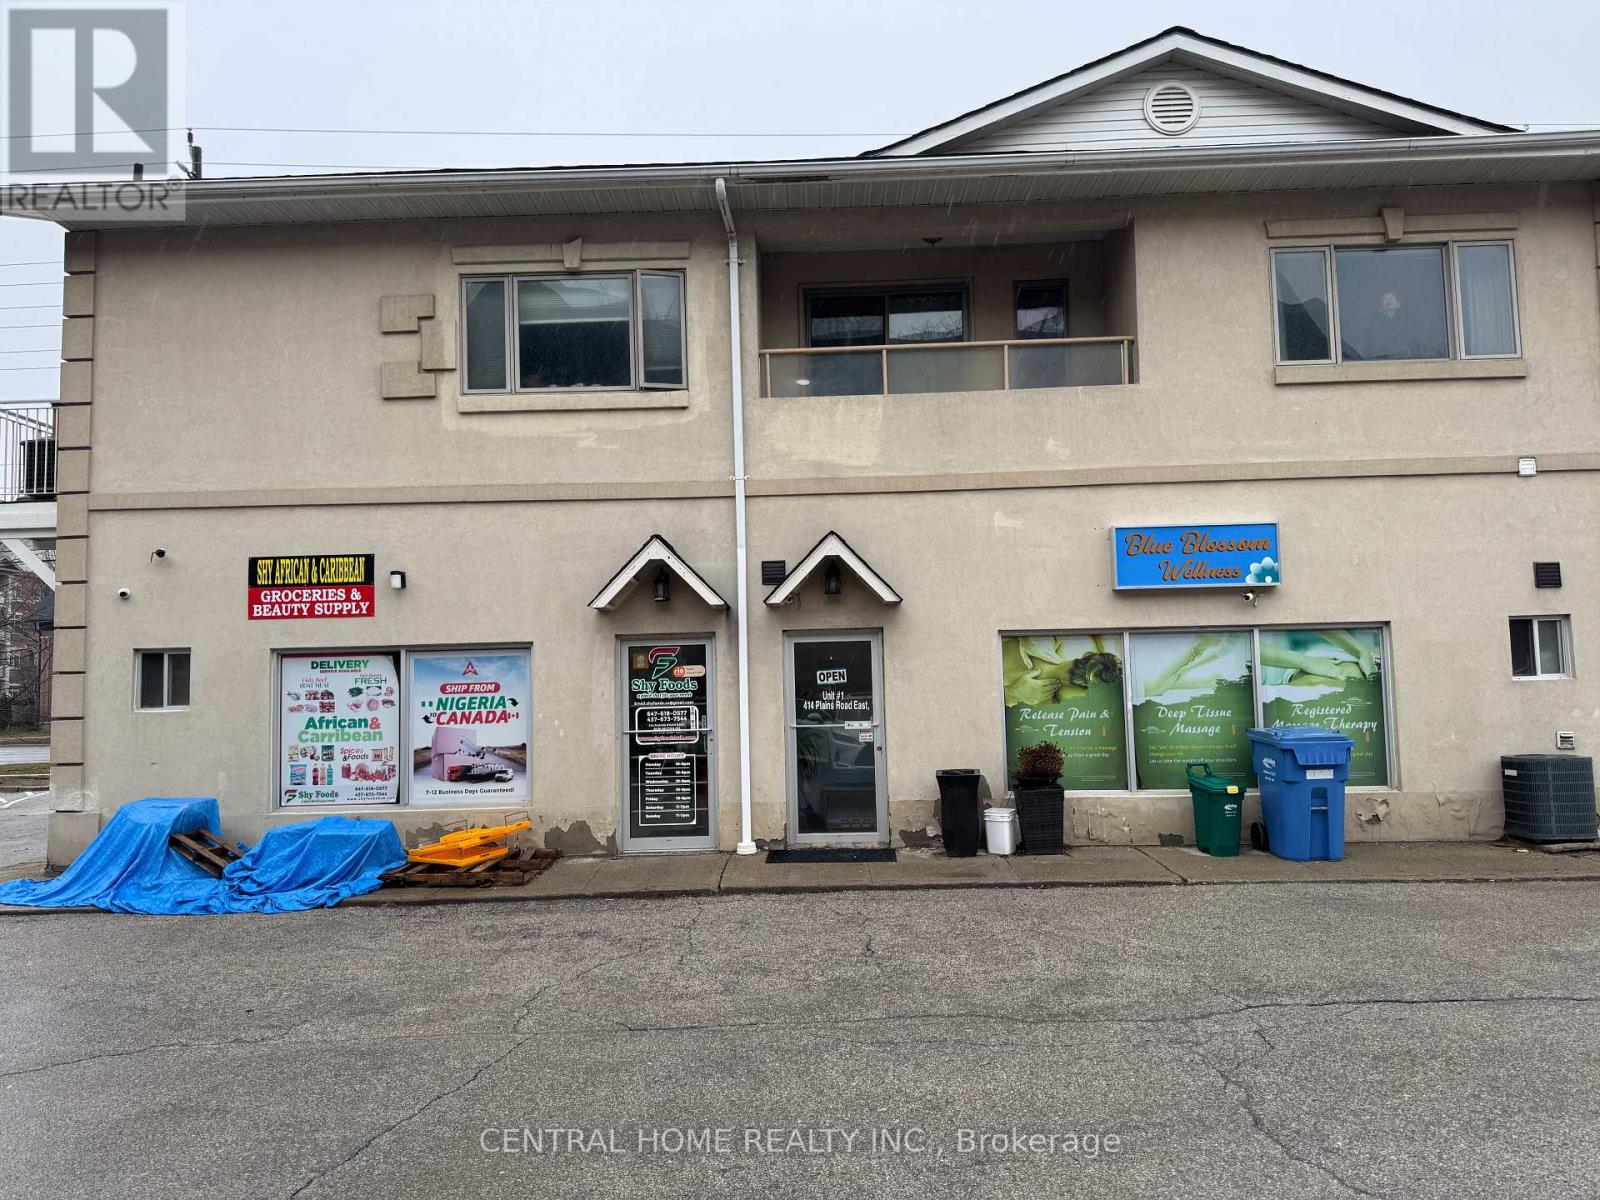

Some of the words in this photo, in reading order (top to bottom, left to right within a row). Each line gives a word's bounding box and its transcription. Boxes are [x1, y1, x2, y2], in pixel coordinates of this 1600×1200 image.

[1125, 532, 1174, 556] Blue
[1180, 531, 1271, 554] Blossom
[257, 560, 273, 584] SHY
[274, 558, 309, 584] AFRICAN
[311, 558, 318, 584] &
[320, 557, 365, 583] CARIBBEAN
[1159, 560, 1241, 582] Wellness
[261, 589, 346, 603] GROCERIES
[350, 588, 361, 600] &
[253, 604, 310, 617] BEAUTY
[315, 602, 369, 615] SUPPLY
[311, 660, 369, 669] DELIVERY
[355, 677, 387, 685] FRESH
[818, 672, 845, 682] OPEN
[445, 685, 467, 693] SHIP
[469, 684, 495, 692] FROM
[631, 679, 657, 692] Shy
[659, 678, 698, 691] Foods
[822, 691, 835, 700] Unit
[836, 691, 844, 700] #1
[436, 696, 507, 711] NIGERIA
[803, 701, 814, 709] 414
[815, 701, 834, 709] Plains
[836, 701, 852, 709] Road
[853, 700, 870, 711] East,
[1291, 703, 1352, 718] Registered
[436, 710, 508, 725] CANADA
[1020, 708, 1064, 721] Release
[1068, 707, 1097, 721] Pain
[1100, 709, 1110, 718] &
[1155, 706, 1187, 720] Deep
[1191, 705, 1233, 718] Tissue
[1043, 724, 1091, 737] Tension
[1169, 723, 1221, 736] Massage
[1323, 717, 1377, 732] Therapy
[298, 729, 383, 744] Carribean
[298, 791, 314, 799] Shy
[316, 790, 339, 798] Foods
